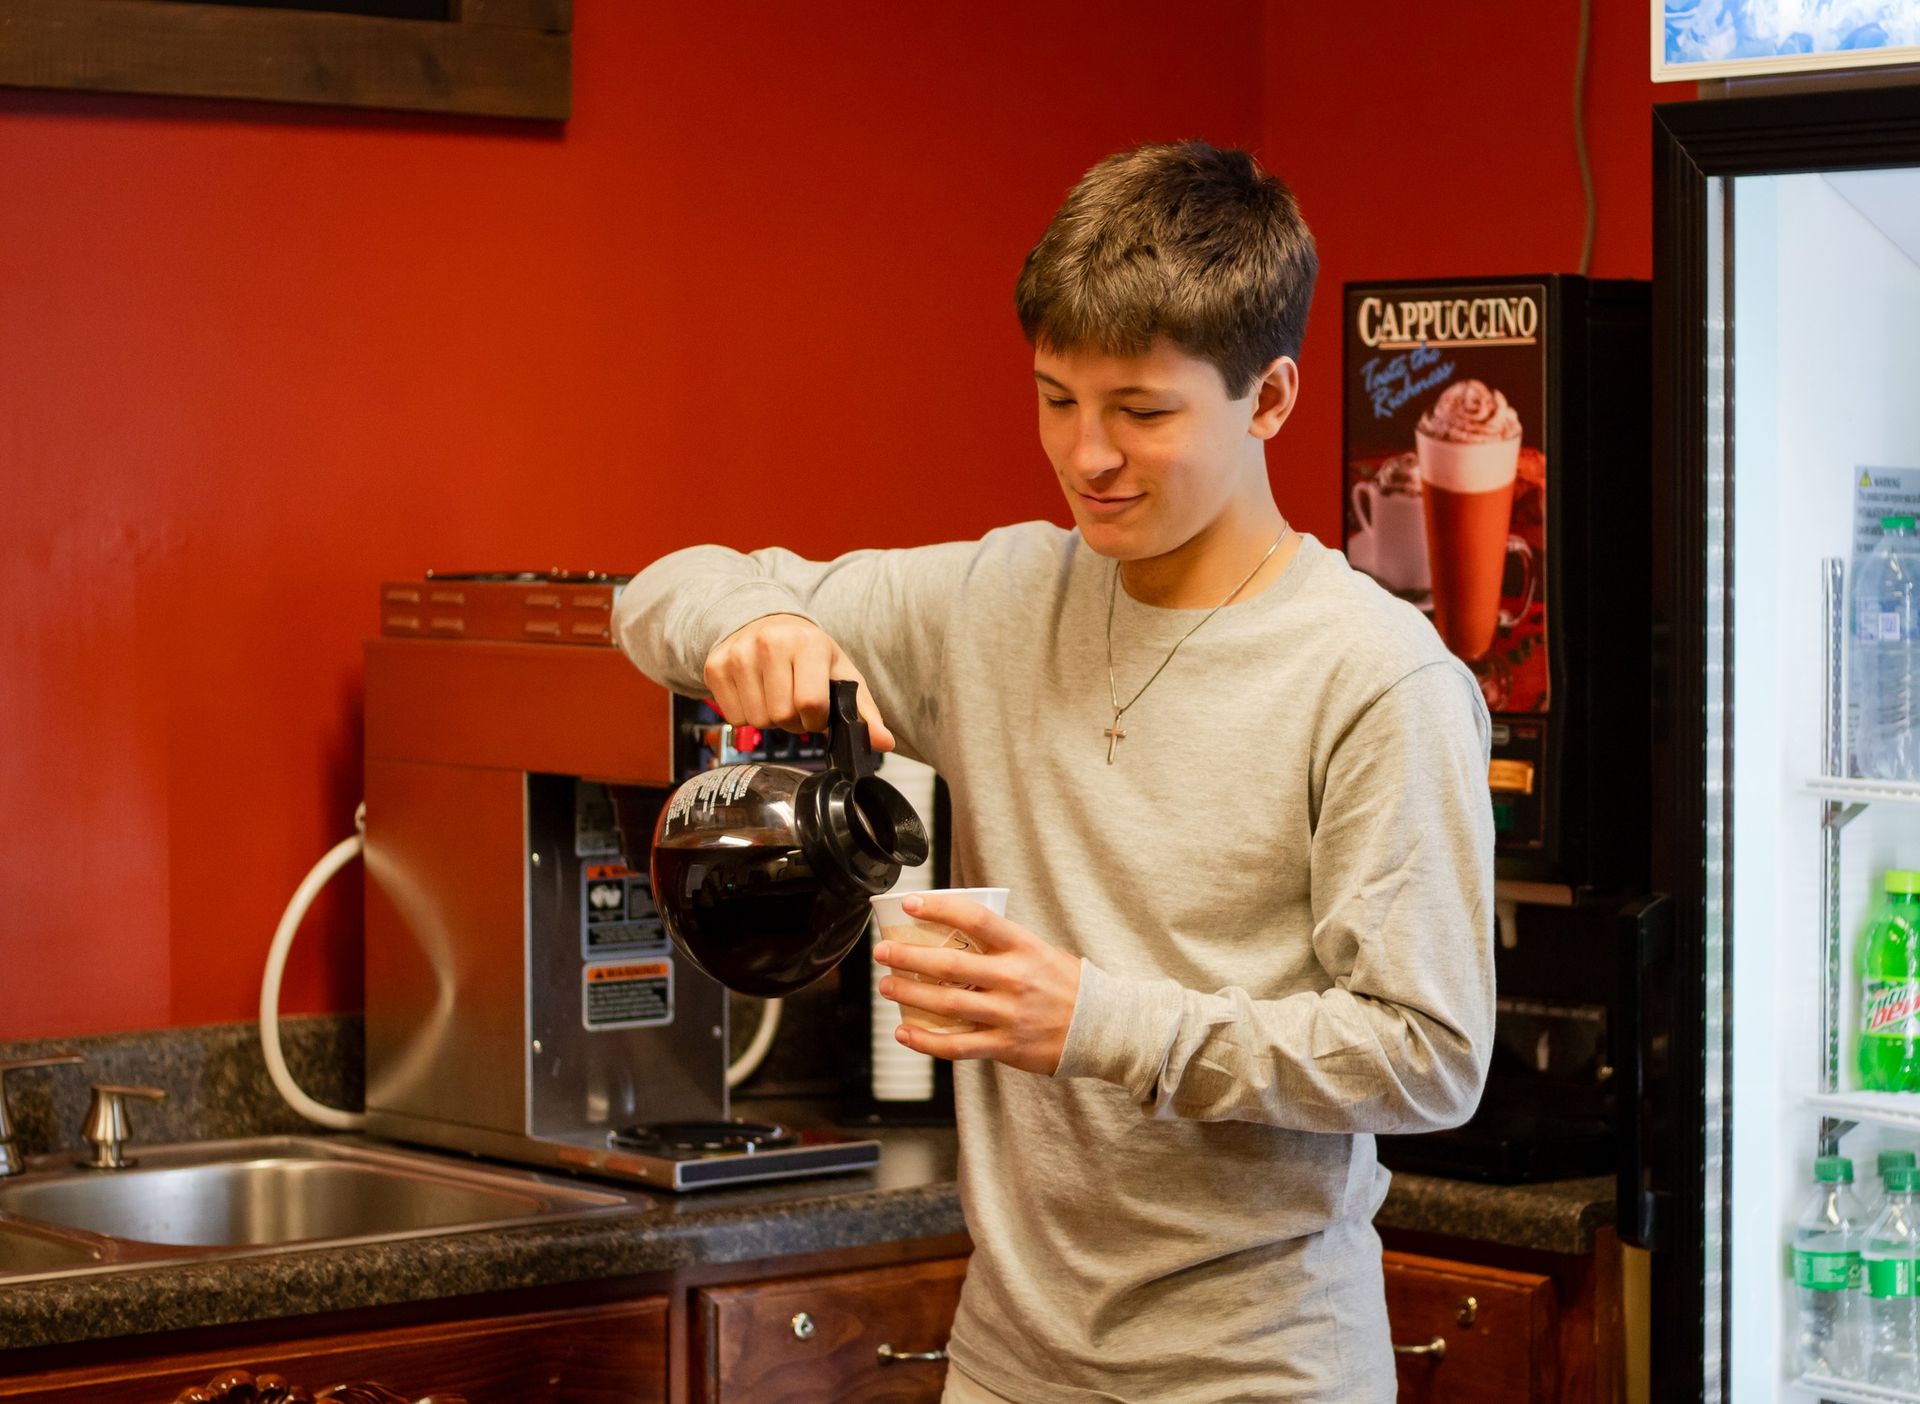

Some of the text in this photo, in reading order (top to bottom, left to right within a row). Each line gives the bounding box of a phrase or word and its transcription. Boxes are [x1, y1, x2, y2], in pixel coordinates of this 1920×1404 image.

[1359, 296, 1538, 347] CAPPUCCINO
[1361, 356, 1407, 392] Taste
[1373, 360, 1456, 419] Richness
